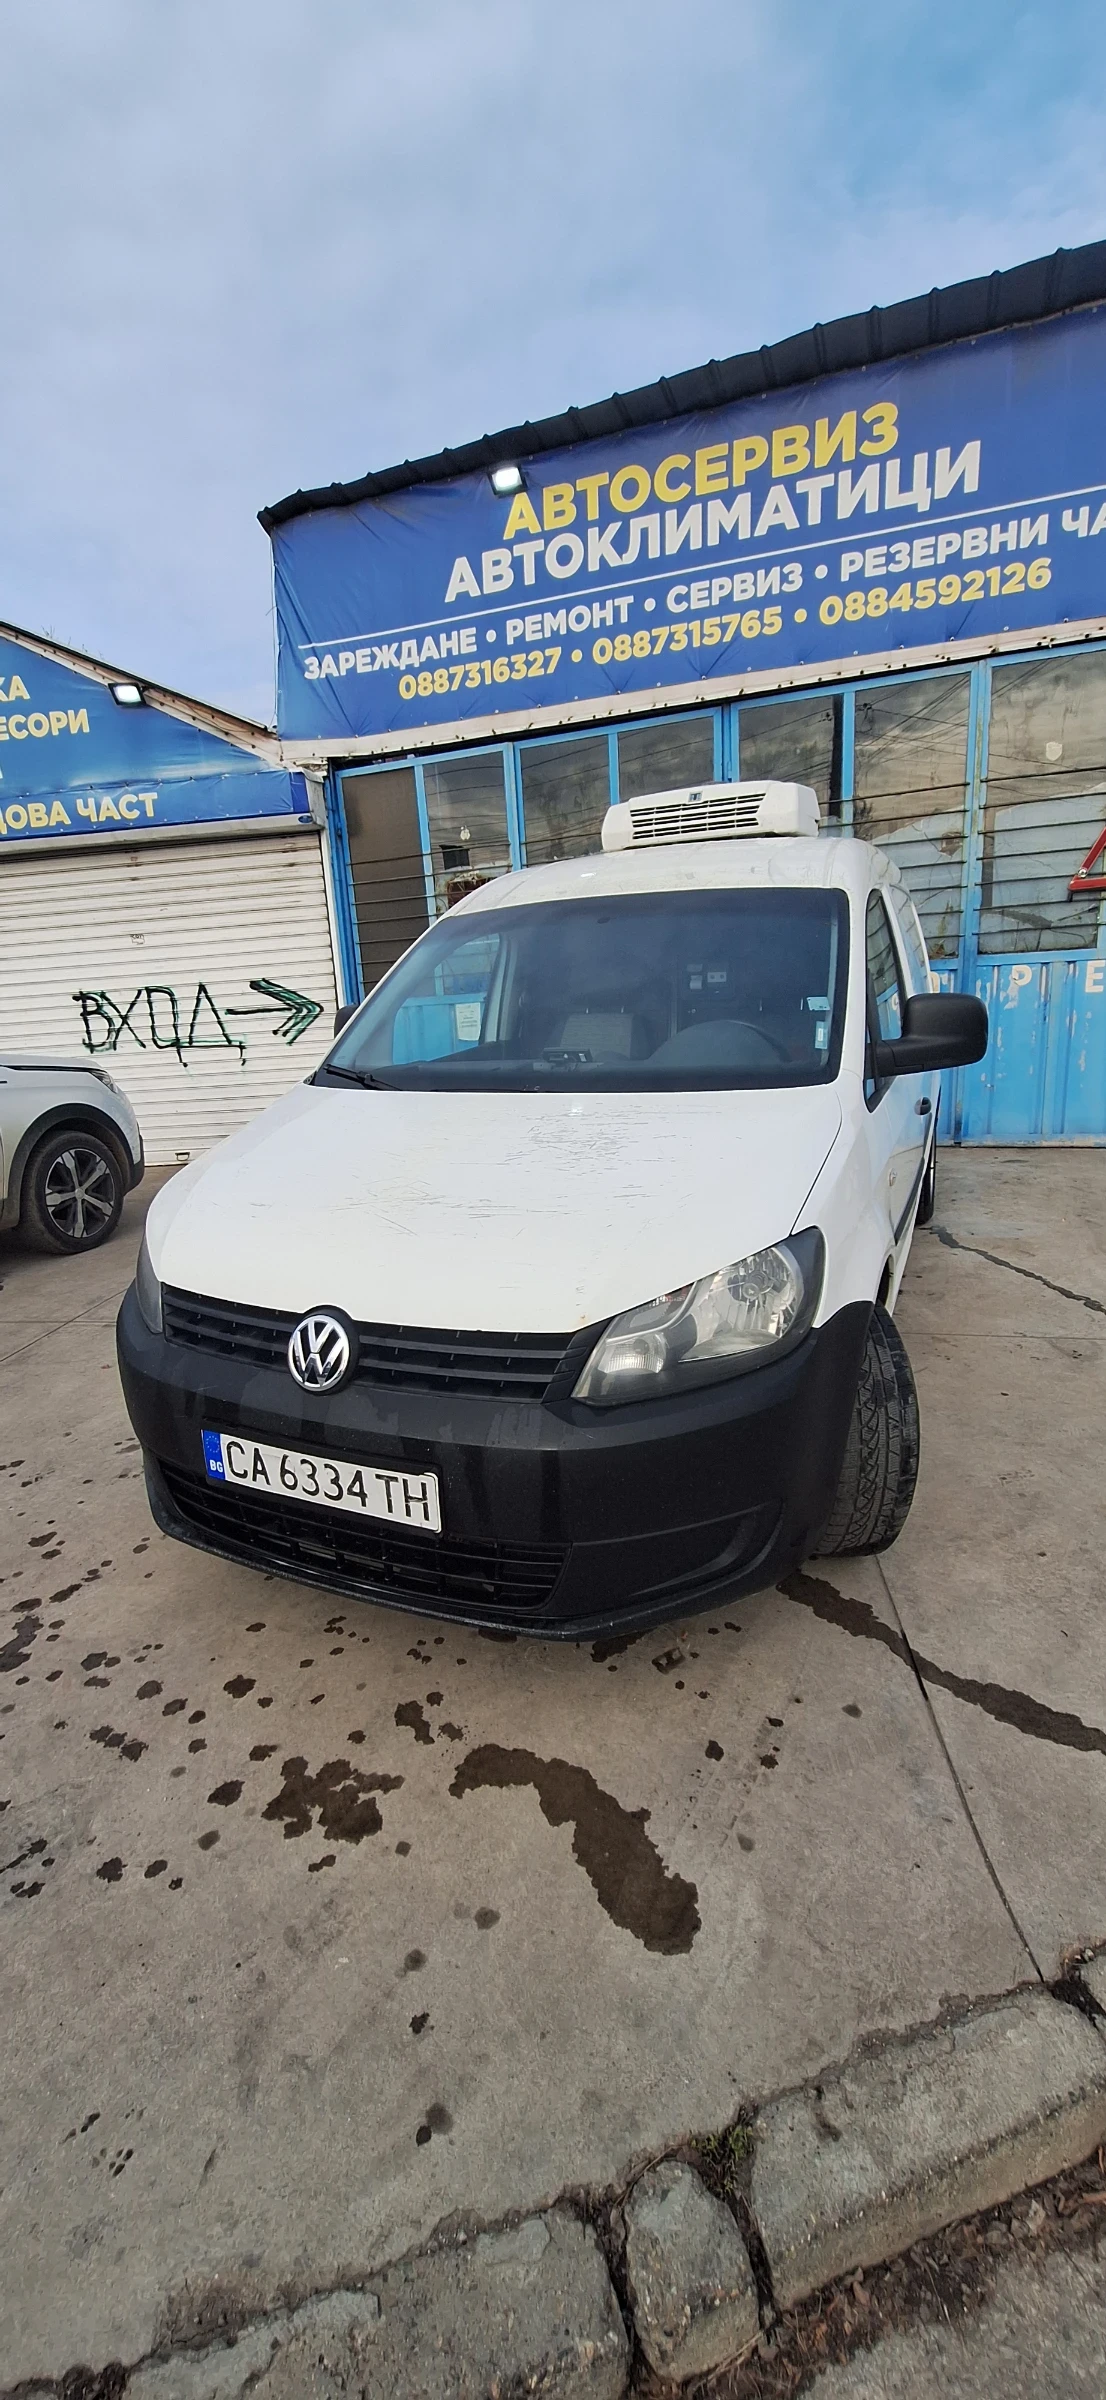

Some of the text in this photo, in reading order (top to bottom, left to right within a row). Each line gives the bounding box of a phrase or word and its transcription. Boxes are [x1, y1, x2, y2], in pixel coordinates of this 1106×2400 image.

[445, 440, 981, 603] АВТОКЛИМАТИЦИ
[503, 402, 899, 540] АВТОСЕРВИЗ
[304, 627, 477, 681] ЗАРЕЖДАНЕ
[506, 595, 634, 645] РЕМОНТ
[667, 563, 803, 613] СЕРВИЗ
[840, 514, 1050, 581] РЕЗЕРВНИ
[399, 557, 1052, 700] 0887316327 0887315765 0884592126
[76, 792, 158, 822] ЧАСТ
[72, 981, 247, 1067] ВХОД
[209, 1459, 224, 1473] BG
